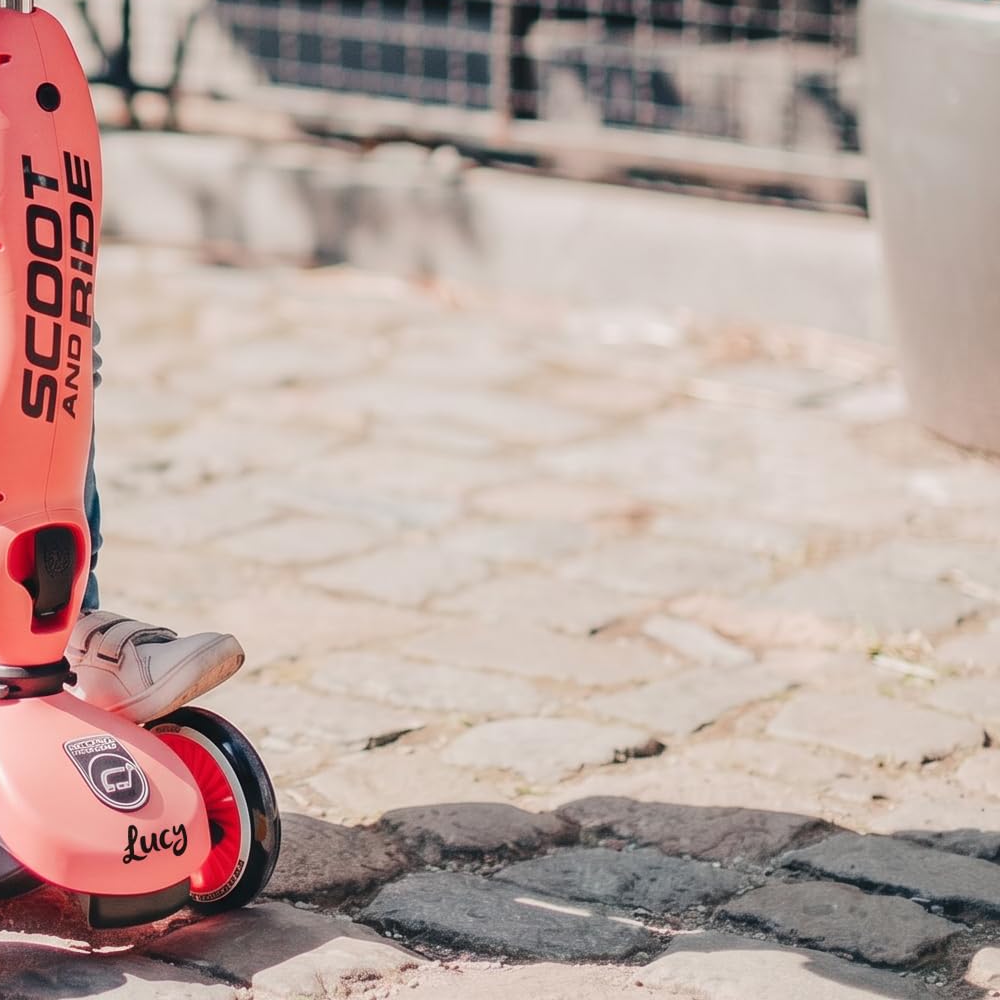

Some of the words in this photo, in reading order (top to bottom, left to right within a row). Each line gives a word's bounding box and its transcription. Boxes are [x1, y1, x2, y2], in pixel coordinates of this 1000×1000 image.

[21, 154, 63, 423] SCOOT
[63, 150, 94, 328] RIDE
[62, 333, 82, 419] AND
[122, 823, 188, 864] Lucy
